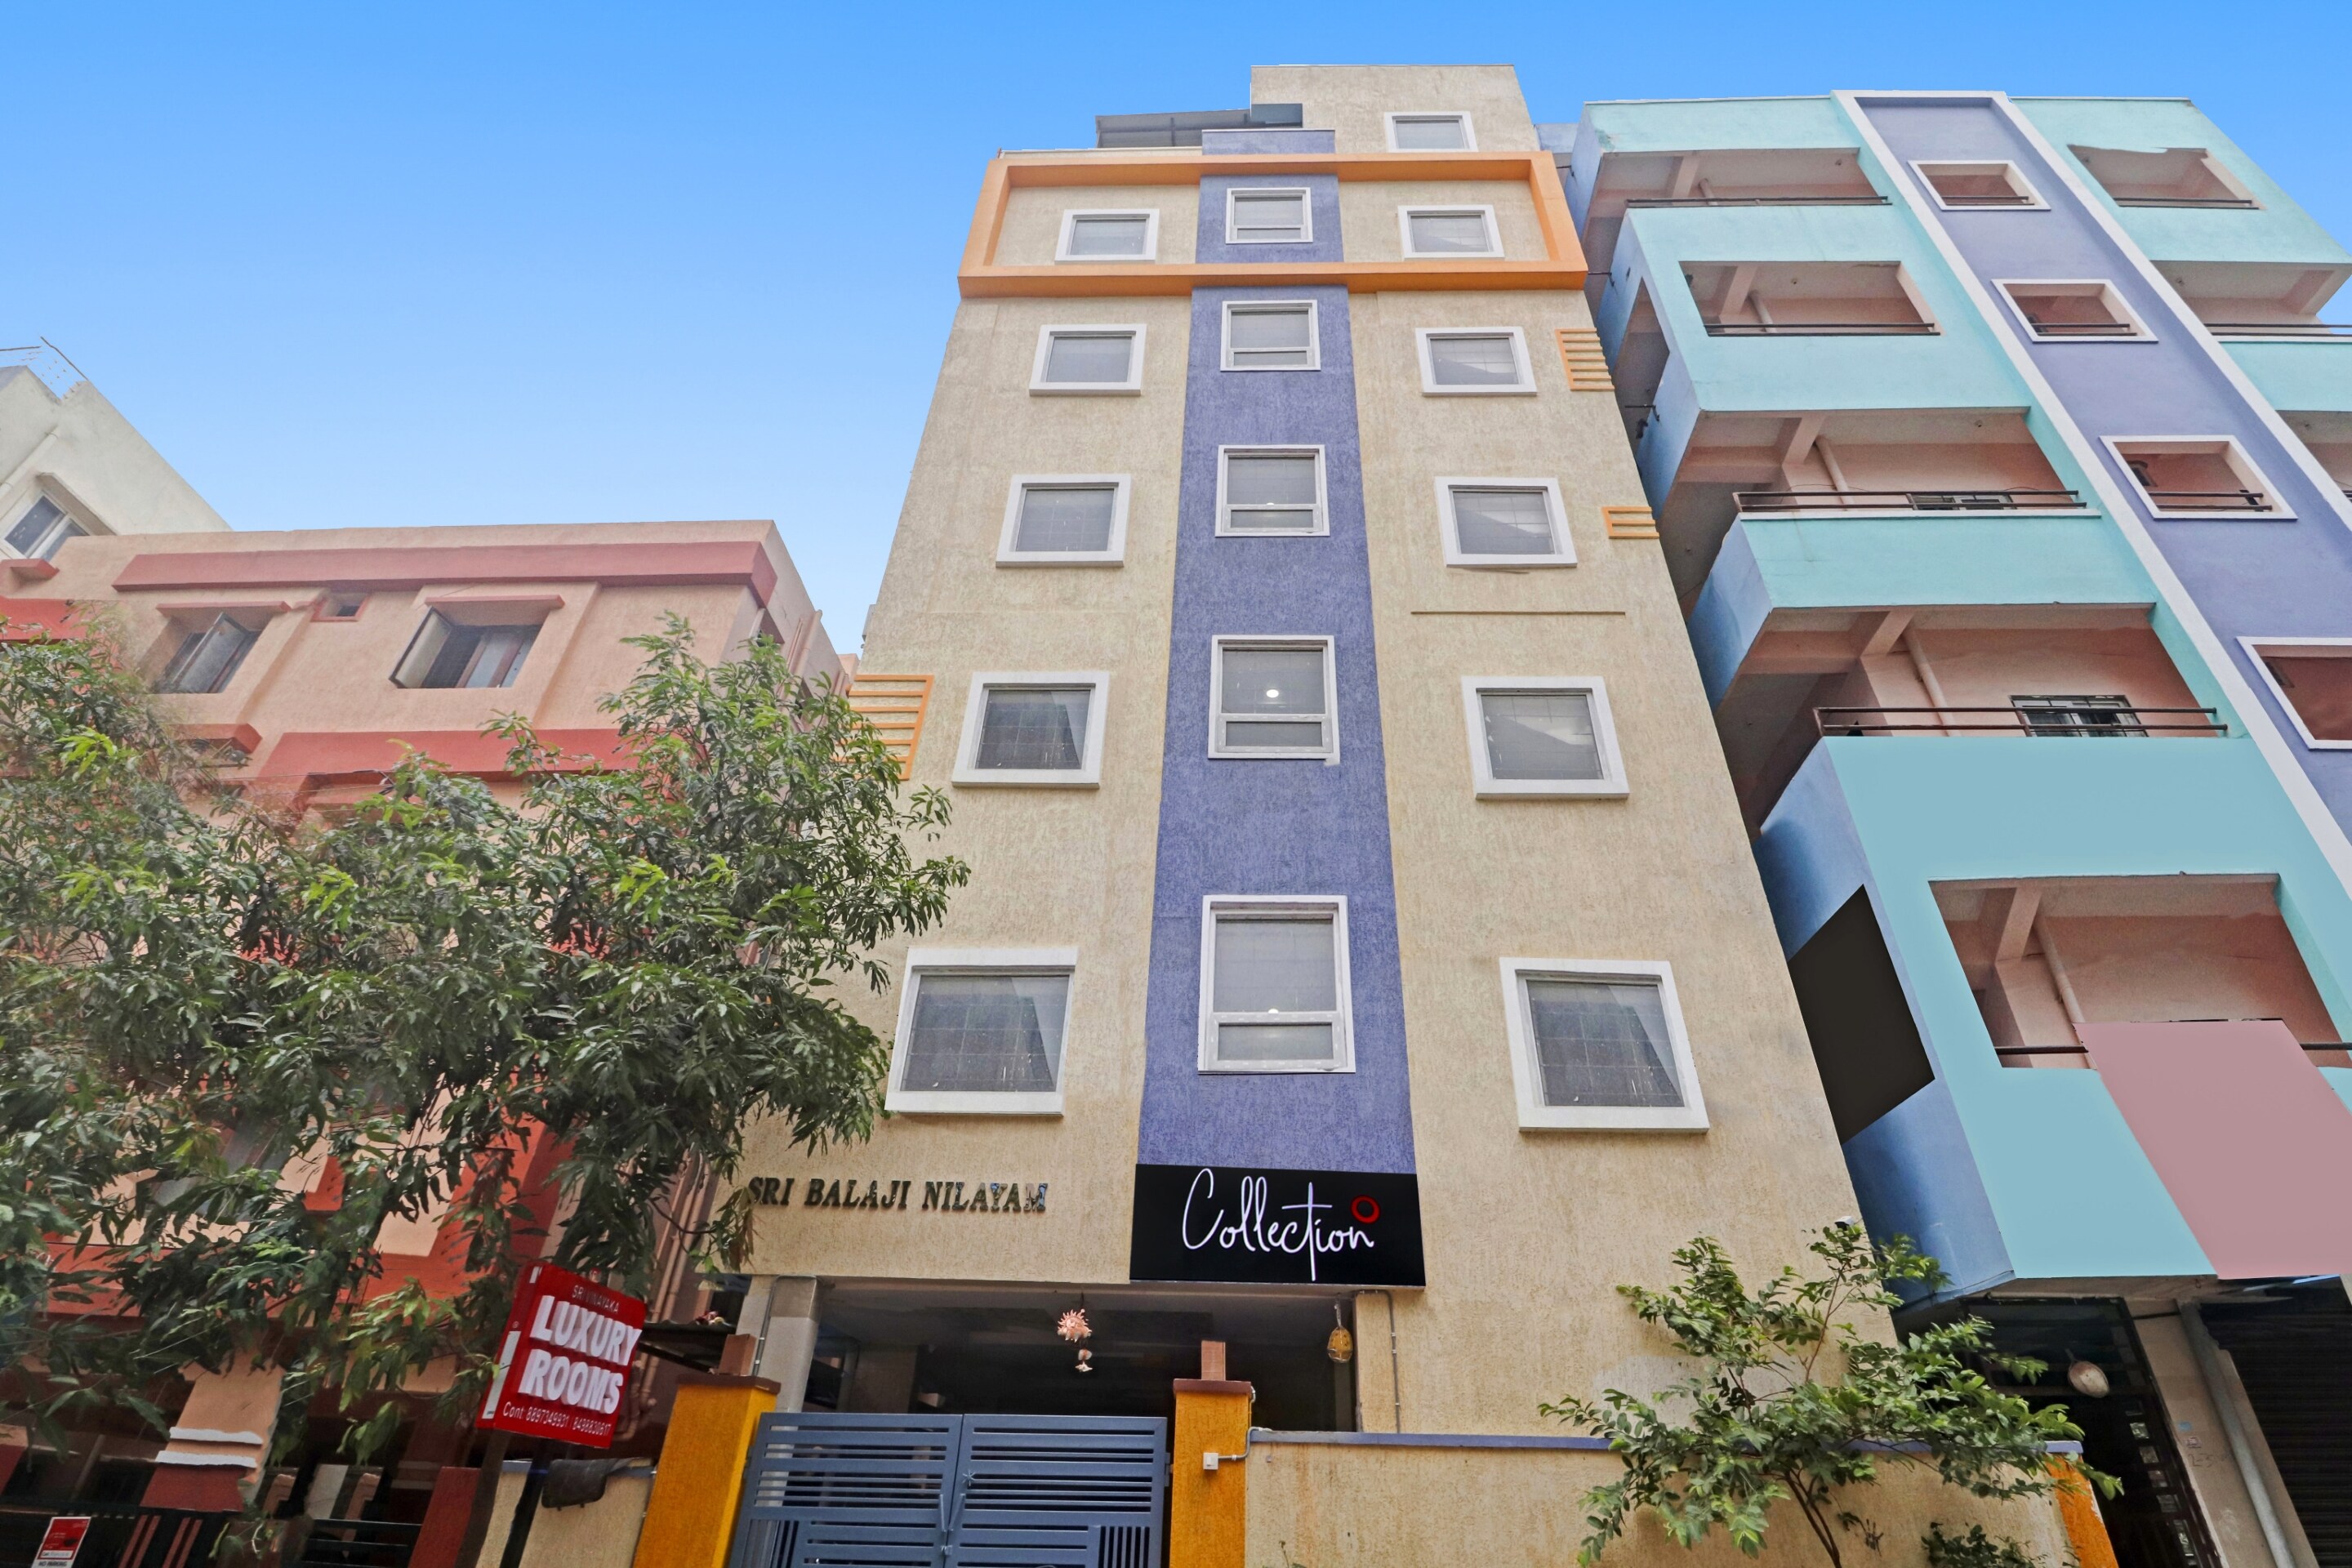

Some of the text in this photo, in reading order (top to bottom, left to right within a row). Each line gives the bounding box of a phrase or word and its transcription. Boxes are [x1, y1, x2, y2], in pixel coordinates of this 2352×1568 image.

[748, 1177, 1049, 1212] SRI BALAJI NILAYAM
[1183, 1168, 1375, 1281] Collection
[529, 1294, 643, 1366] LUXURY
[518, 1348, 624, 1414] ROOMS
